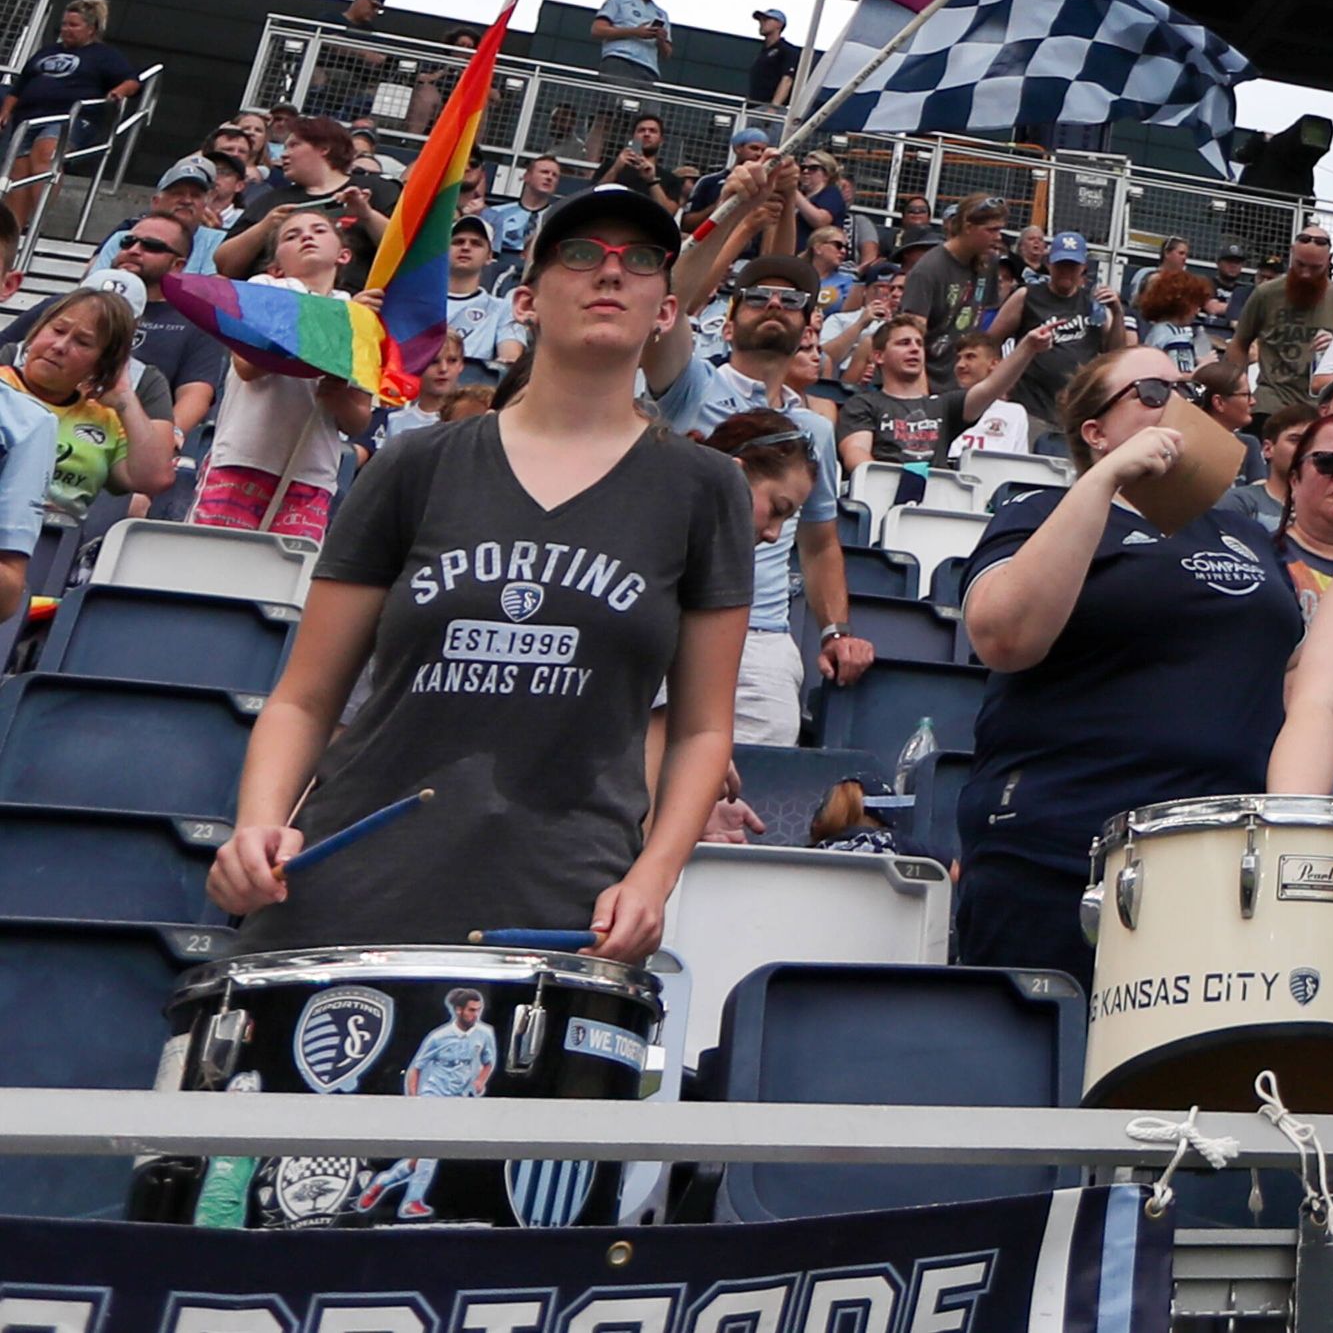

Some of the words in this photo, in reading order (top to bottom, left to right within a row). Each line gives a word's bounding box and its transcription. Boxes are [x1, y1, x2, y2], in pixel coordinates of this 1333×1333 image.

[1180, 557, 1266, 575] COMPASS
[410, 540, 648, 613] SPORTING
[1194, 571, 1267, 582] MINERALS
[411, 661, 520, 697] KANSAS
[529, 665, 594, 697] CITY
[246, 697, 264, 710] 23
[192, 824, 214, 839] 23
[905, 865, 921, 877] 21
[186, 935, 211, 952] 23
[1031, 978, 1050, 993] 21
[1101, 974, 1191, 1016] KANSAS
[311, 1000, 383, 1019] SPORTING
[290, 1217, 333, 1230] LOYALTY
